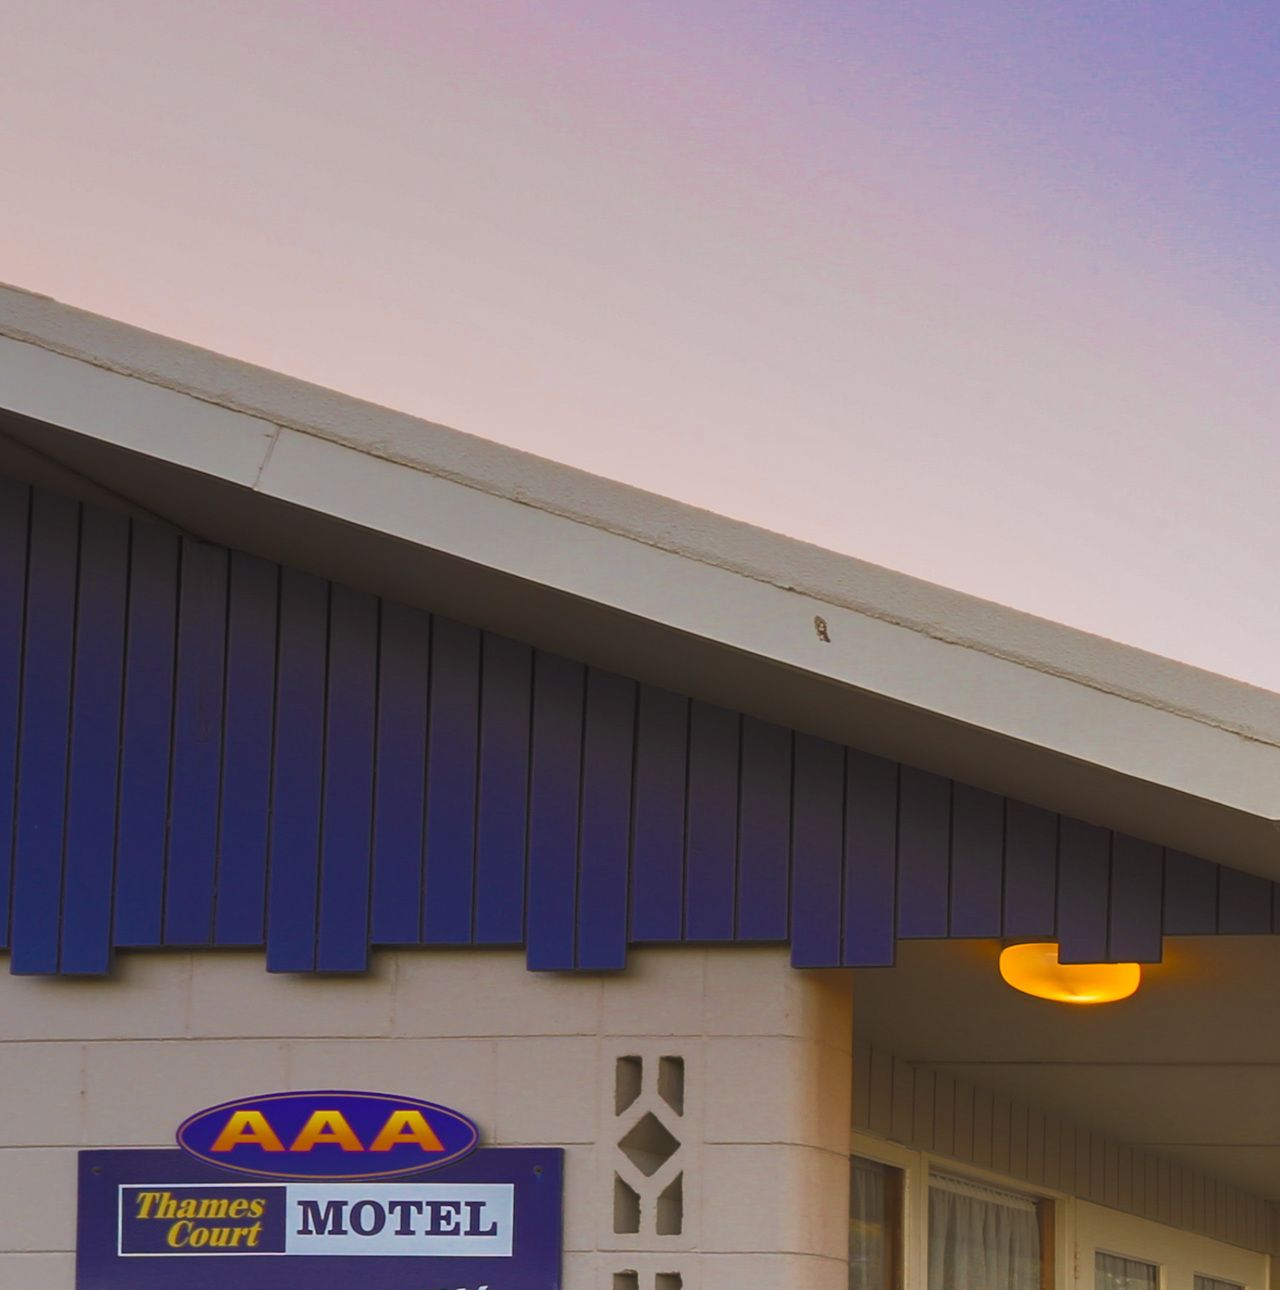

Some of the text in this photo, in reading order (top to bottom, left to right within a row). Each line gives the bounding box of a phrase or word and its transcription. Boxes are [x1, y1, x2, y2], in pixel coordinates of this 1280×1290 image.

[209, 1109, 446, 1153] AAA
[135, 1192, 266, 1219] Thames
[296, 1200, 499, 1237] MOTEL
[166, 1220, 262, 1247] Court
